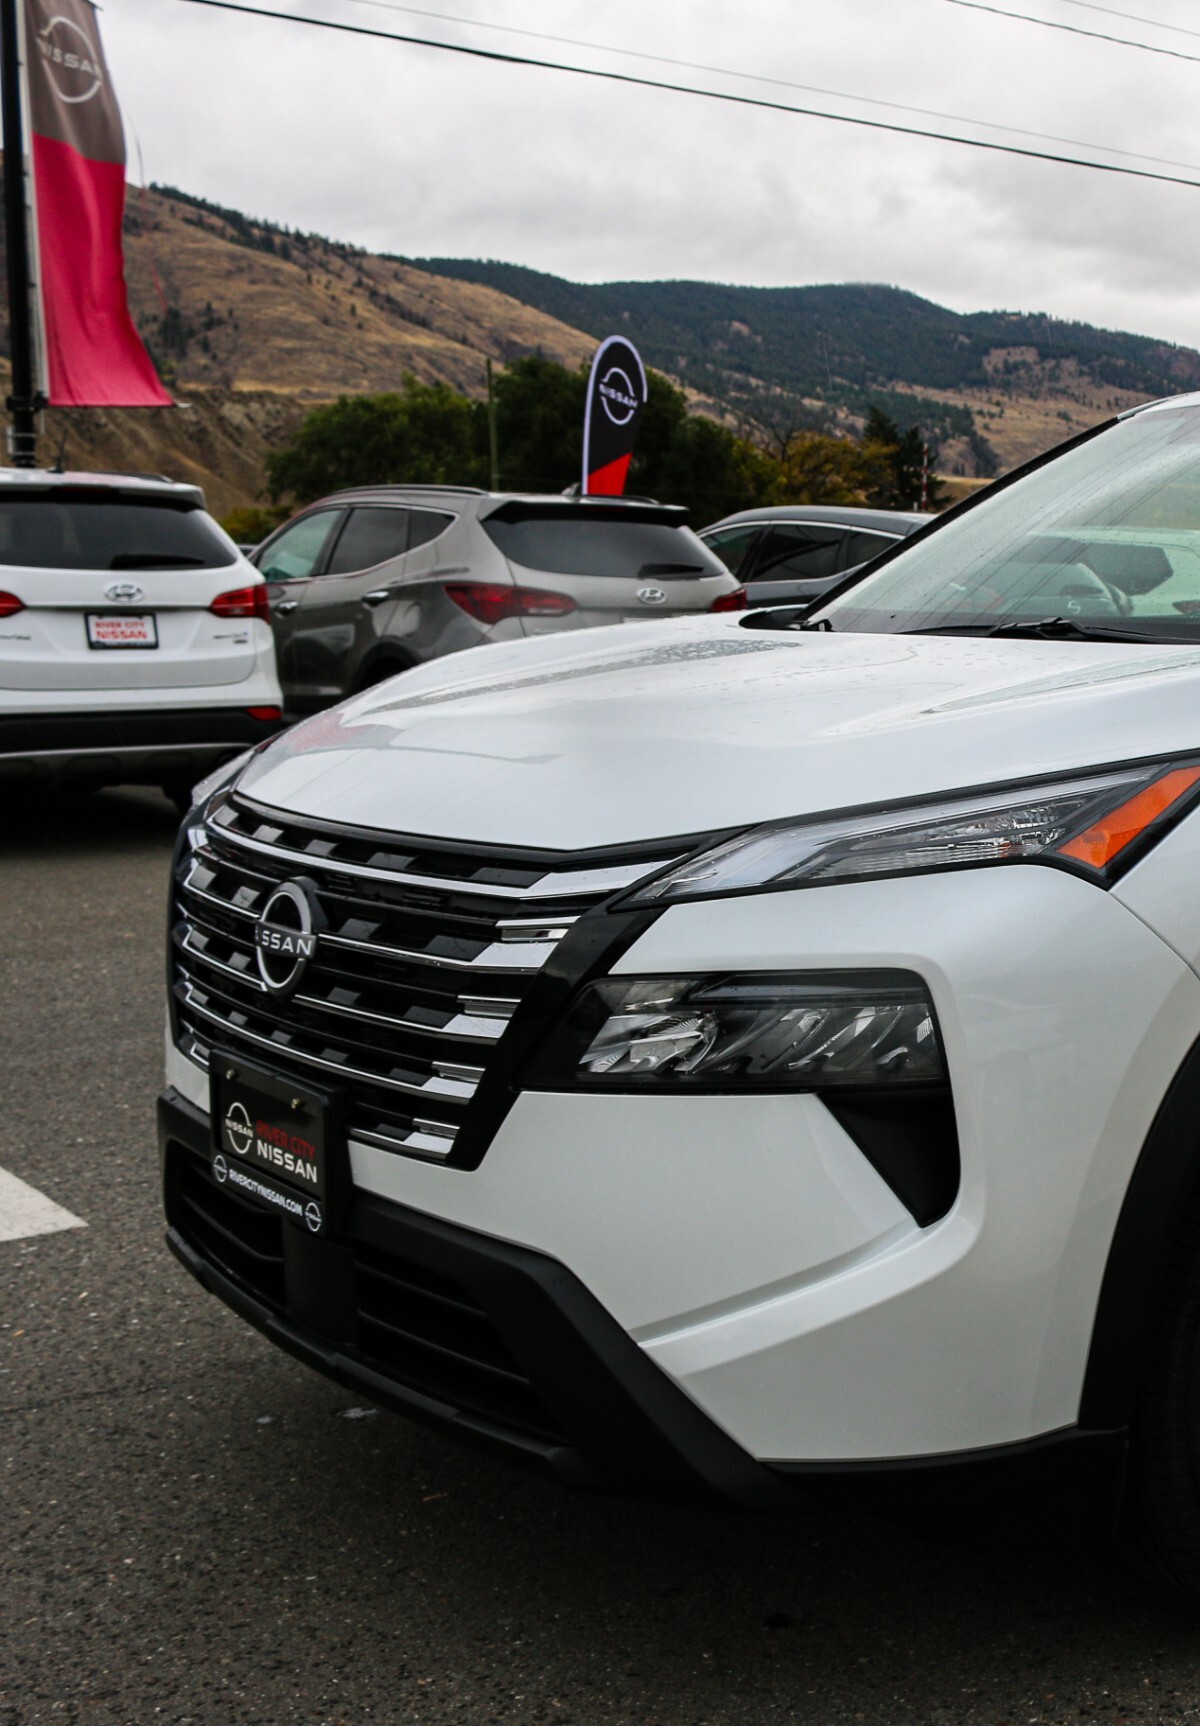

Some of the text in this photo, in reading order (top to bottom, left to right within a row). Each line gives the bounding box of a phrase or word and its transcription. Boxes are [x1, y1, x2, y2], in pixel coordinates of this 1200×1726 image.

[599, 384, 638, 408] NISSAN
[95, 621, 145, 629] RIVER CITY
[95, 630, 147, 639] NISSAN
[225, 1118, 254, 1138] NISSAN
[256, 1119, 316, 1162] RIVER CITY
[256, 1139, 318, 1184] NISSAN
